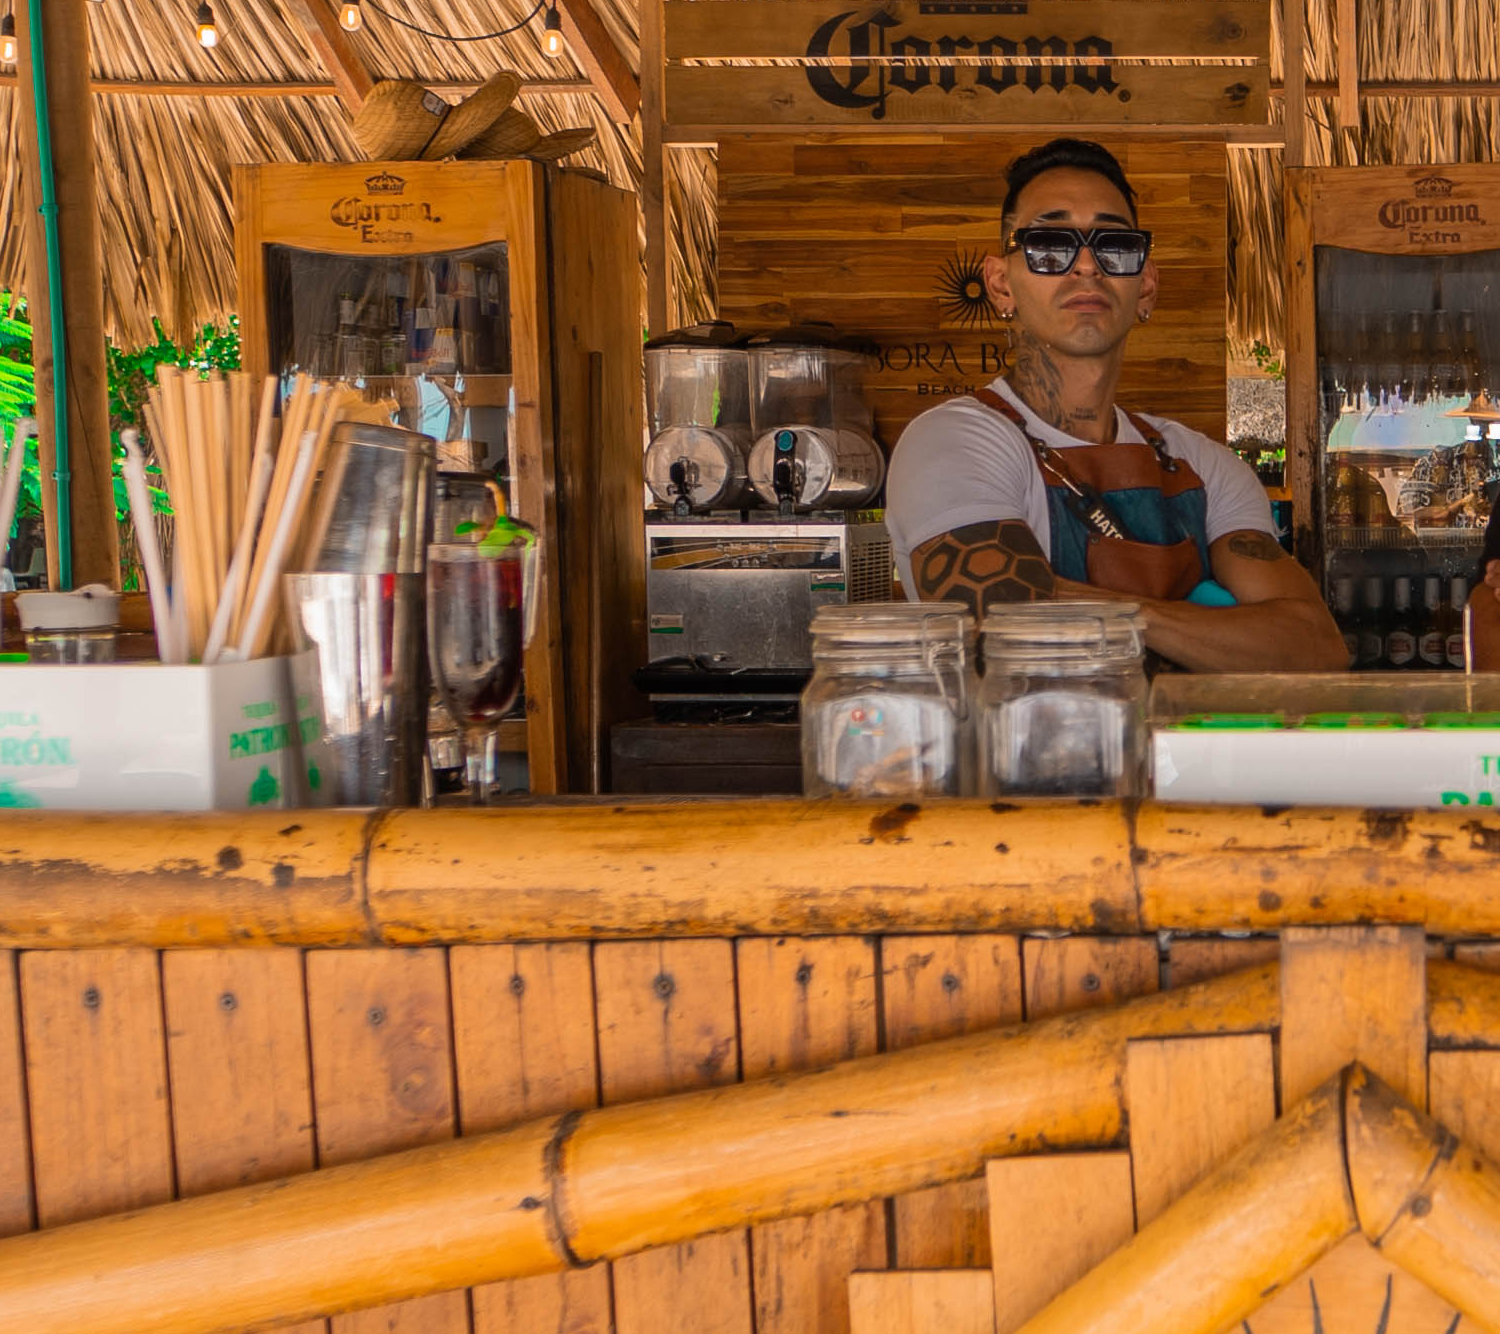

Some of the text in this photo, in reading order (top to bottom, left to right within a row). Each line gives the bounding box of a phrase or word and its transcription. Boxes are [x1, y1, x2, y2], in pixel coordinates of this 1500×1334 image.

[806, 3, 1121, 118] Corona
[331, 196, 433, 230] Corona
[1379, 198, 1482, 231] Corona
[1408, 227, 1461, 244] Extra
[917, 383, 975, 395] BEACH
